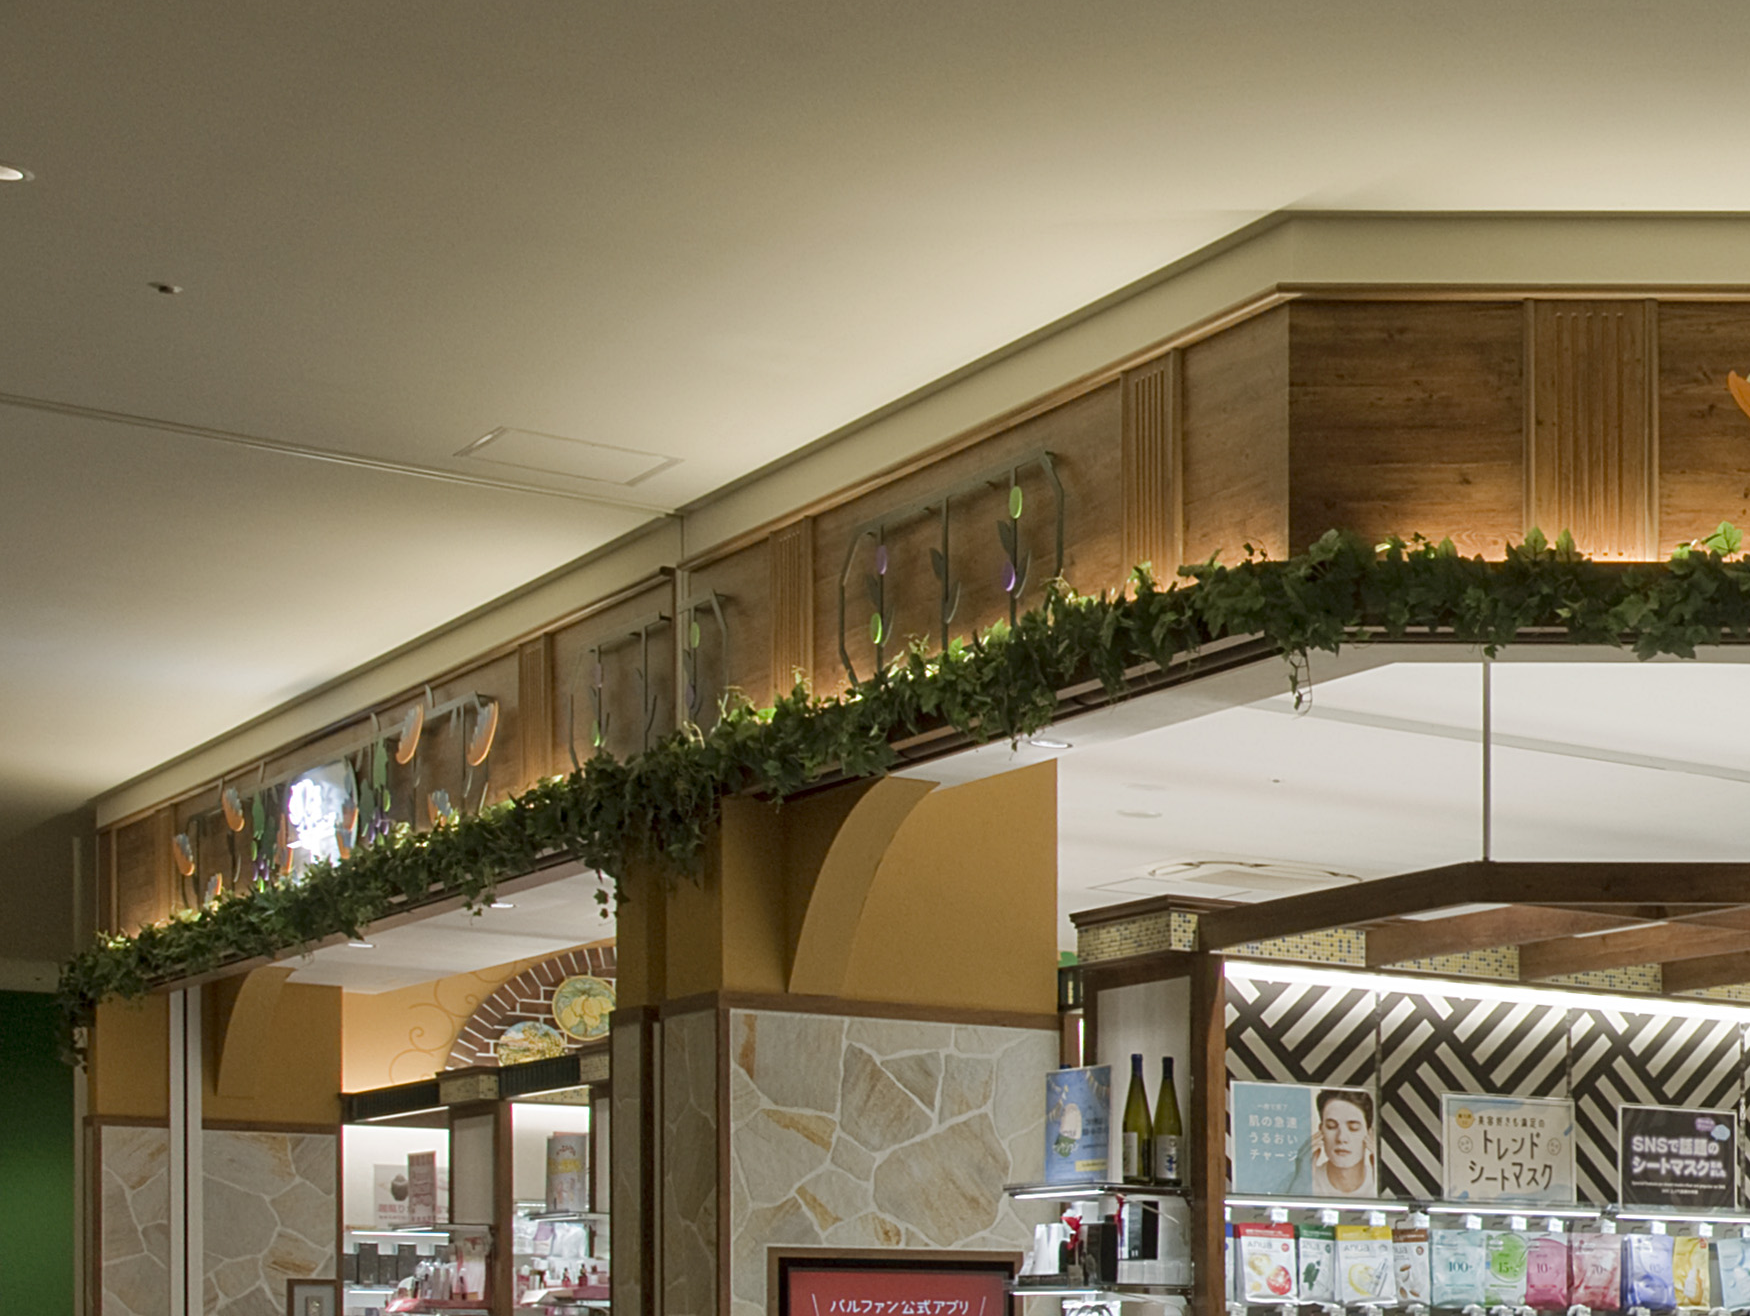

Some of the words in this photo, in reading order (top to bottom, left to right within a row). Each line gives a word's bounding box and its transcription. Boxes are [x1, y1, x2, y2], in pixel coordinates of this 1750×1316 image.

[1248, 1114, 1298, 1129] 肌の急速
[1248, 1133, 1298, 1145] うるおい
[1483, 1129, 1541, 1161] トレンド
[1631, 1136, 1720, 1157] SNSで話題の
[1250, 1148, 1298, 1162] チャージ
[1468, 1160, 1553, 1192] シートマスク
